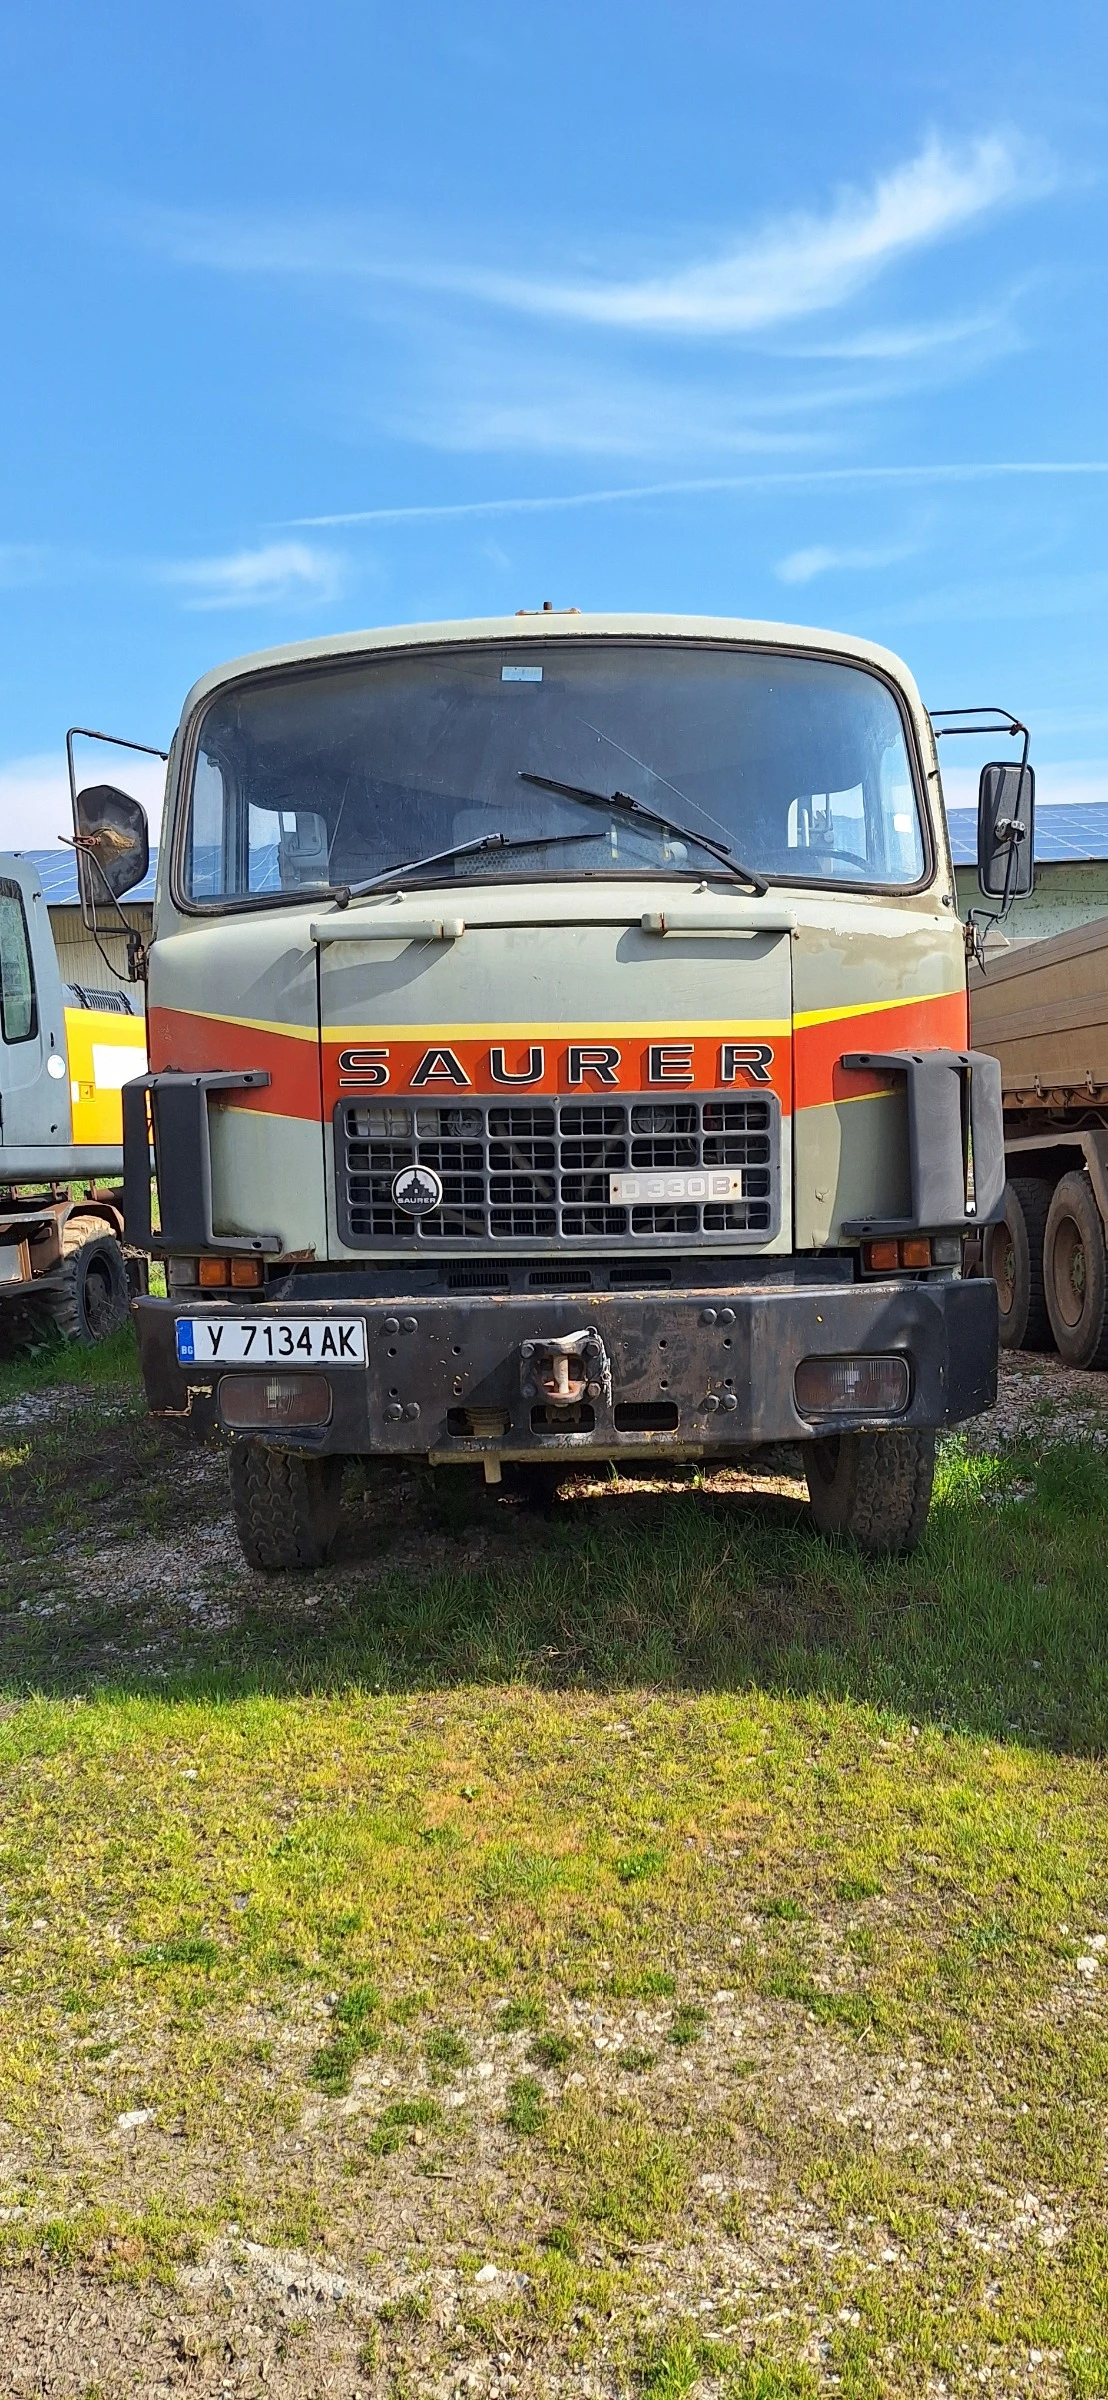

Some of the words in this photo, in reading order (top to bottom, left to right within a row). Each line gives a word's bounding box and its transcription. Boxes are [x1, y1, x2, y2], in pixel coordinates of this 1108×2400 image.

[338, 1043, 775, 1087] SAURER
[621, 1179, 640, 1198] D
[181, 1345, 194, 1356] BG
[241, 1326, 313, 1357] 7134
